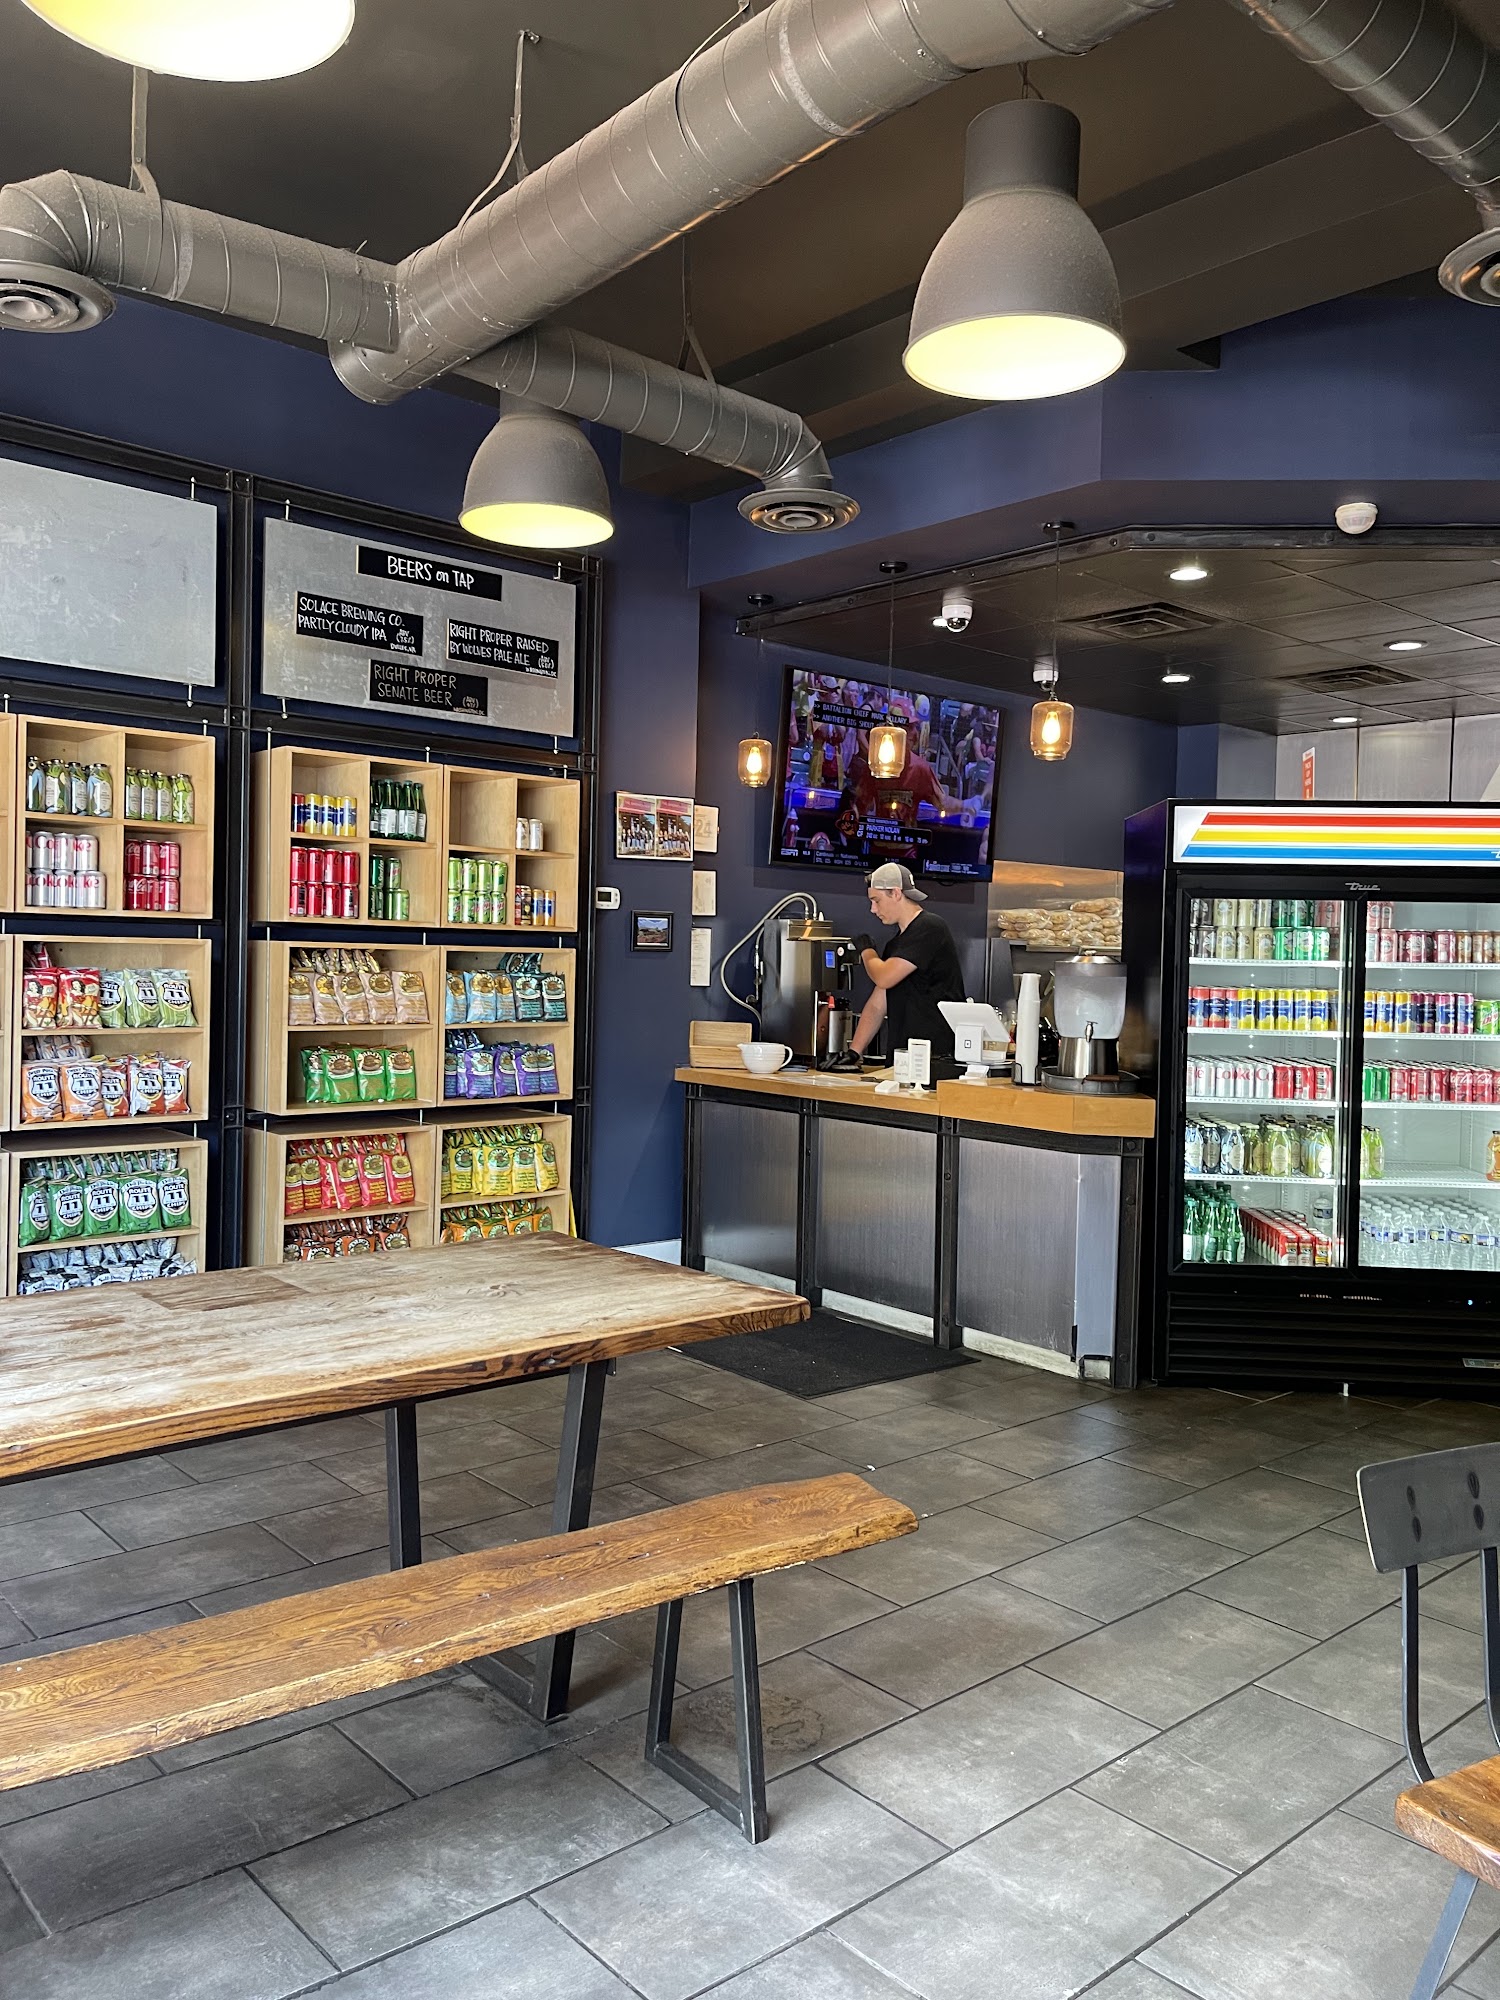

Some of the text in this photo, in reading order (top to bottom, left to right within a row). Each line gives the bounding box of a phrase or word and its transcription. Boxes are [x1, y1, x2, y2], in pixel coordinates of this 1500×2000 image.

[387, 556, 474, 590] BEERS on TAP
[300, 596, 405, 626] SOLACE BREWING CO.
[298, 614, 388, 642] PARTLY CLOUDY IPA
[450, 622, 549, 654] RIGHT PROPER RAISED
[450, 640, 461, 654] BY
[462, 643, 492, 658] WOLVES
[494, 648, 513, 664] PALE
[514, 652, 530, 666] ALE
[374, 664, 457, 689] RIGHT PROPER
[378, 682, 419, 701] SENATE
[424, 689, 452, 706] BEER
[1345, 882, 1380, 890] True
[37, 1082, 53, 1090] 11
[64, 1201, 78, 1210] 11
[96, 1196, 110, 1205] 11
